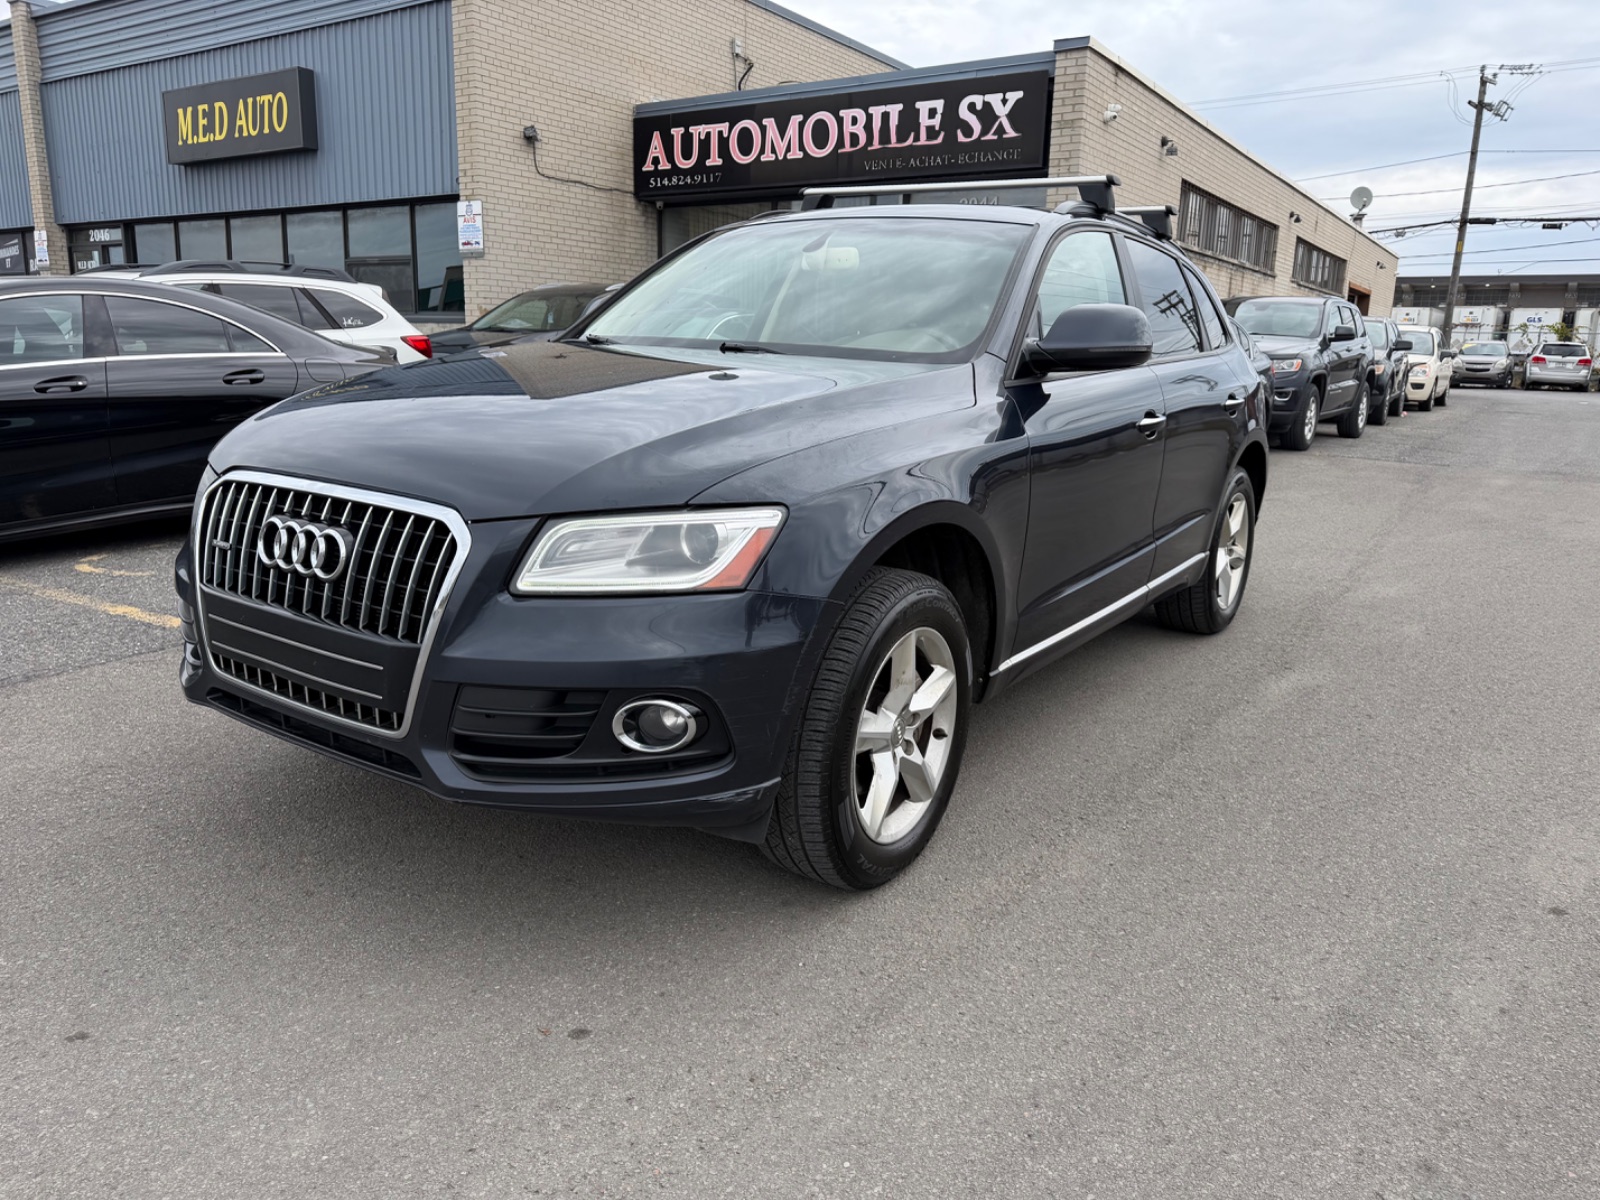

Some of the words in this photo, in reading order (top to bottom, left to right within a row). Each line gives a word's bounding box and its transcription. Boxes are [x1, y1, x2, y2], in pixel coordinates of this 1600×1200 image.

[177, 101, 228, 146] M.E.D
[234, 91, 288, 138] AUTO
[641, 98, 945, 172] AUTOMOBILE
[956, 90, 1024, 144] SX
[648, 172, 722, 188] 514.824.9117
[88, 228, 111, 242] 2046
[1526, 316, 1543, 324] GLS
